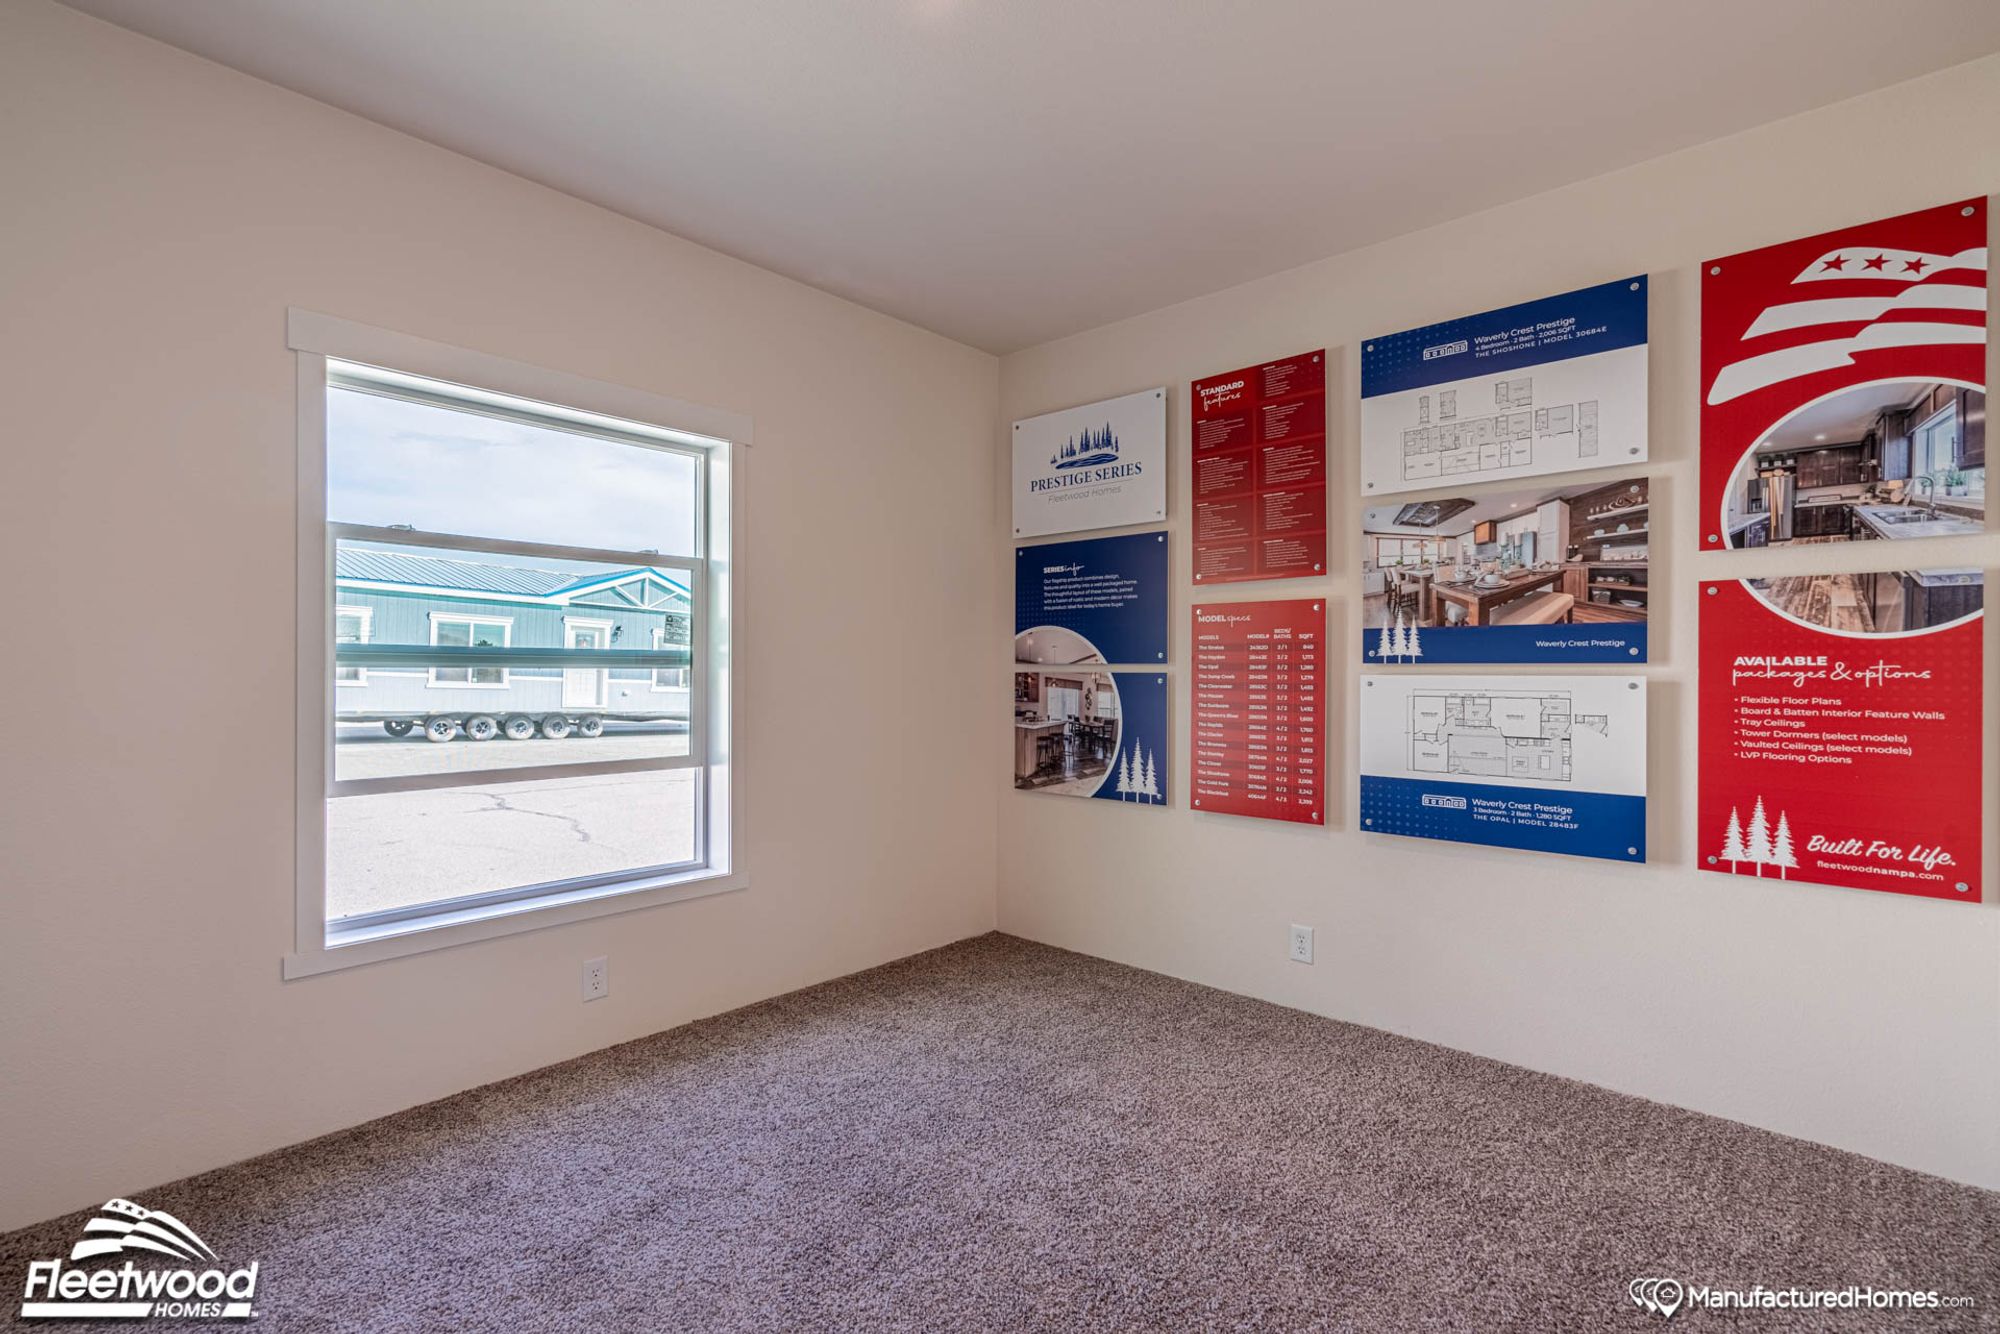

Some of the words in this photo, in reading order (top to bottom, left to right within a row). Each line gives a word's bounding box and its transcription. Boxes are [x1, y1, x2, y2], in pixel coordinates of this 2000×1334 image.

[1474, 331, 1509, 344] Waverly
[1511, 326, 1534, 336] Crest
[1536, 317, 1575, 331] Prestige
[1481, 340, 1510, 350] Bedroom
[1539, 330, 1557, 338] 2,006
[1492, 342, 1535, 355] SHOSHONE
[1544, 334, 1573, 344] MODEL
[1576, 326, 1607, 337] 30684E
[1200, 381, 1244, 397] STANDARD
[1203, 392, 1241, 412] features
[1030, 470, 1093, 492] PRESTIGE
[1095, 462, 1143, 481] SERIES
[1048, 490, 1090, 504] Fleetwood
[1091, 485, 1122, 498] Homes
[1043, 565, 1064, 574] SERIES
[1199, 615, 1226, 623] MODEL
[1536, 640, 1567, 648] Waverly
[1568, 639, 1590, 647] Crest
[1591, 639, 1625, 648] Prestige
[1734, 655, 1828, 667] AVAILABLE
[1732, 657, 1827, 687] packages
[1831, 662, 1852, 681] &
[1855, 660, 1931, 688] options
[1741, 696, 1780, 705] Flexible
[1782, 696, 1809, 706] Floor
[1811, 697, 1842, 706] Plans
[1741, 707, 1771, 716] Board
[1772, 708, 1781, 716] &
[1784, 708, 1819, 717] Batten
[1822, 709, 1862, 718] Interior
[1865, 710, 1910, 720] Feature
[1912, 711, 1945, 720] Walls
[1741, 719, 1762, 728] Tray
[1764, 719, 1806, 729] Ceilings
[1741, 729, 1771, 738] Tower
[1773, 730, 1820, 740] Dormers
[1822, 732, 1858, 742] (select
[1861, 733, 1908, 744] models)
[1741, 740, 1780, 750] Vaulted
[1782, 741, 1824, 753] Ceilings
[1826, 743, 1863, 754] (select
[1865, 745, 1912, 756] models)
[1741, 751, 1760, 759] LVP
[1762, 752, 1806, 763] Flooring
[1808, 754, 1852, 765] Options
[1472, 799, 1506, 809] Waverly
[1508, 802, 1532, 810] Crest
[1534, 804, 1573, 814] Prestige
[1807, 834, 1863, 857] Built
[1866, 840, 1903, 860] For
[1908, 844, 1957, 870] Life.
[1817, 860, 1944, 881] fleetwoodnampa.com
